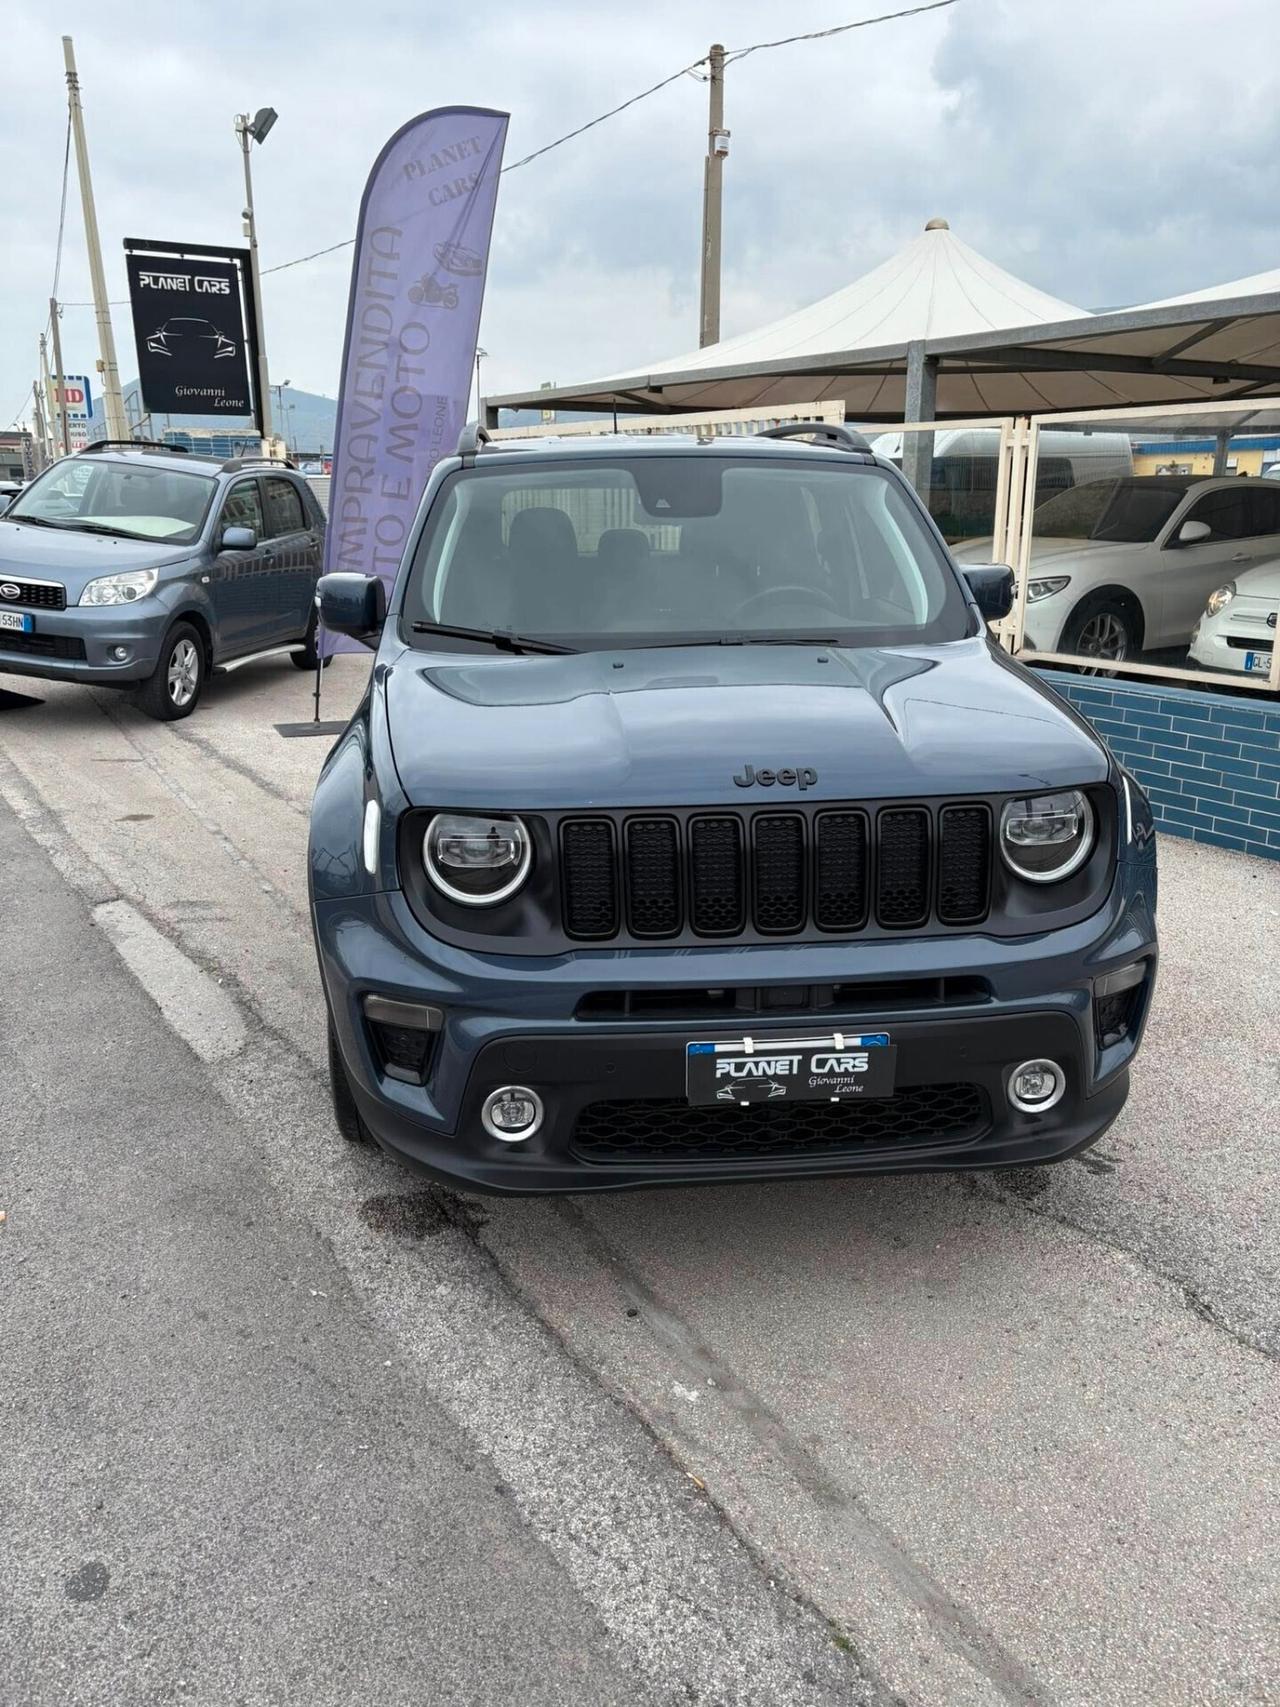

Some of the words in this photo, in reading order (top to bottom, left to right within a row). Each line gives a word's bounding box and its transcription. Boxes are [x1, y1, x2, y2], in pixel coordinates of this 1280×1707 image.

[402, 135, 482, 182] PLANET
[428, 172, 479, 207] CARS
[138, 271, 191, 292] PLANET
[194, 275, 231, 295] CARS
[175, 385, 225, 397] Giovanni
[213, 397, 245, 408] Leone
[337, 226, 403, 570] MPRAVENDITA
[386, 321, 430, 463] MOTO
[431, 395, 448, 445] LEONE
[732, 763, 818, 792] Jeep
[715, 1055, 803, 1079] PLANET
[810, 1052, 869, 1074] CARS
[808, 1075, 855, 1088] Giovanni
[833, 1084, 865, 1094] Leone
